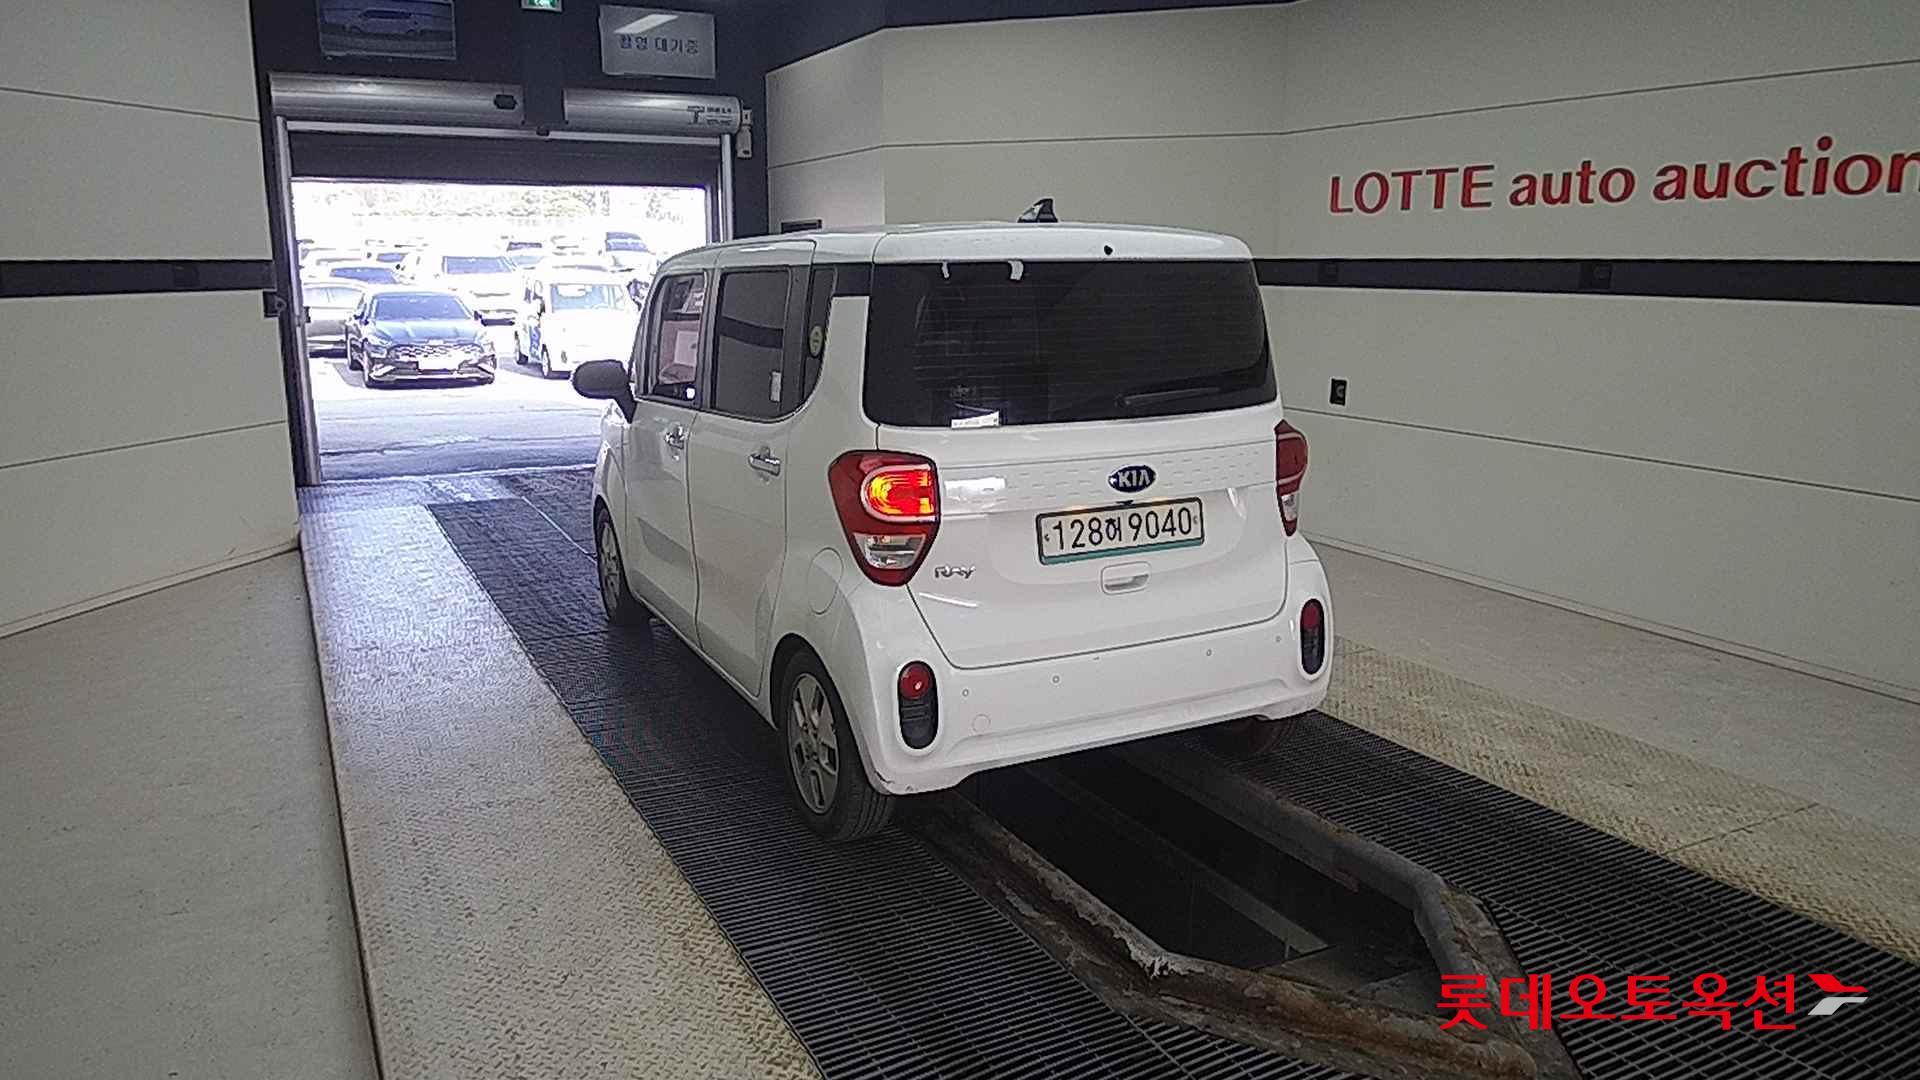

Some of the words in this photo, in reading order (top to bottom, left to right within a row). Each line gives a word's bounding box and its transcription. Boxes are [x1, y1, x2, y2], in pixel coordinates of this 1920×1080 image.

[1330, 165, 1495, 214] LOTTE
[1510, 160, 1636, 207] auto
[1652, 136, 1920, 201] auction
[1117, 469, 1151, 488] KIA
